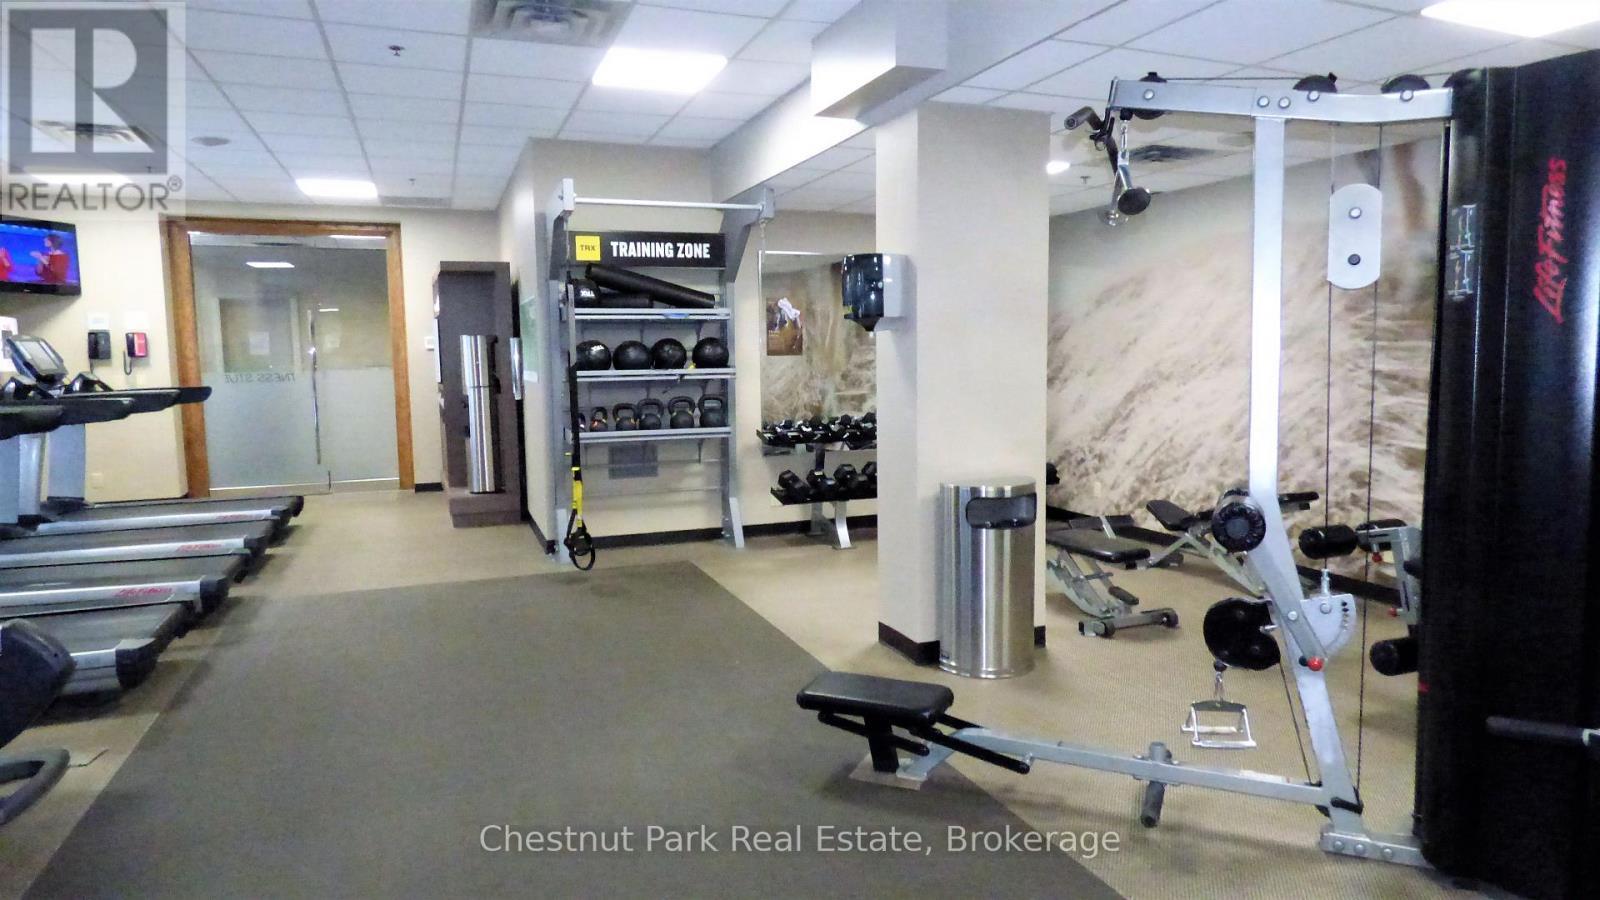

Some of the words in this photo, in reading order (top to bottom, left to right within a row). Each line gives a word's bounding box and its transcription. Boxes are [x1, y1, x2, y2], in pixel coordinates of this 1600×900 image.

[580, 244, 596, 252] TRX
[610, 241, 674, 258] TRAINING
[677, 243, 711, 259] ZONE
